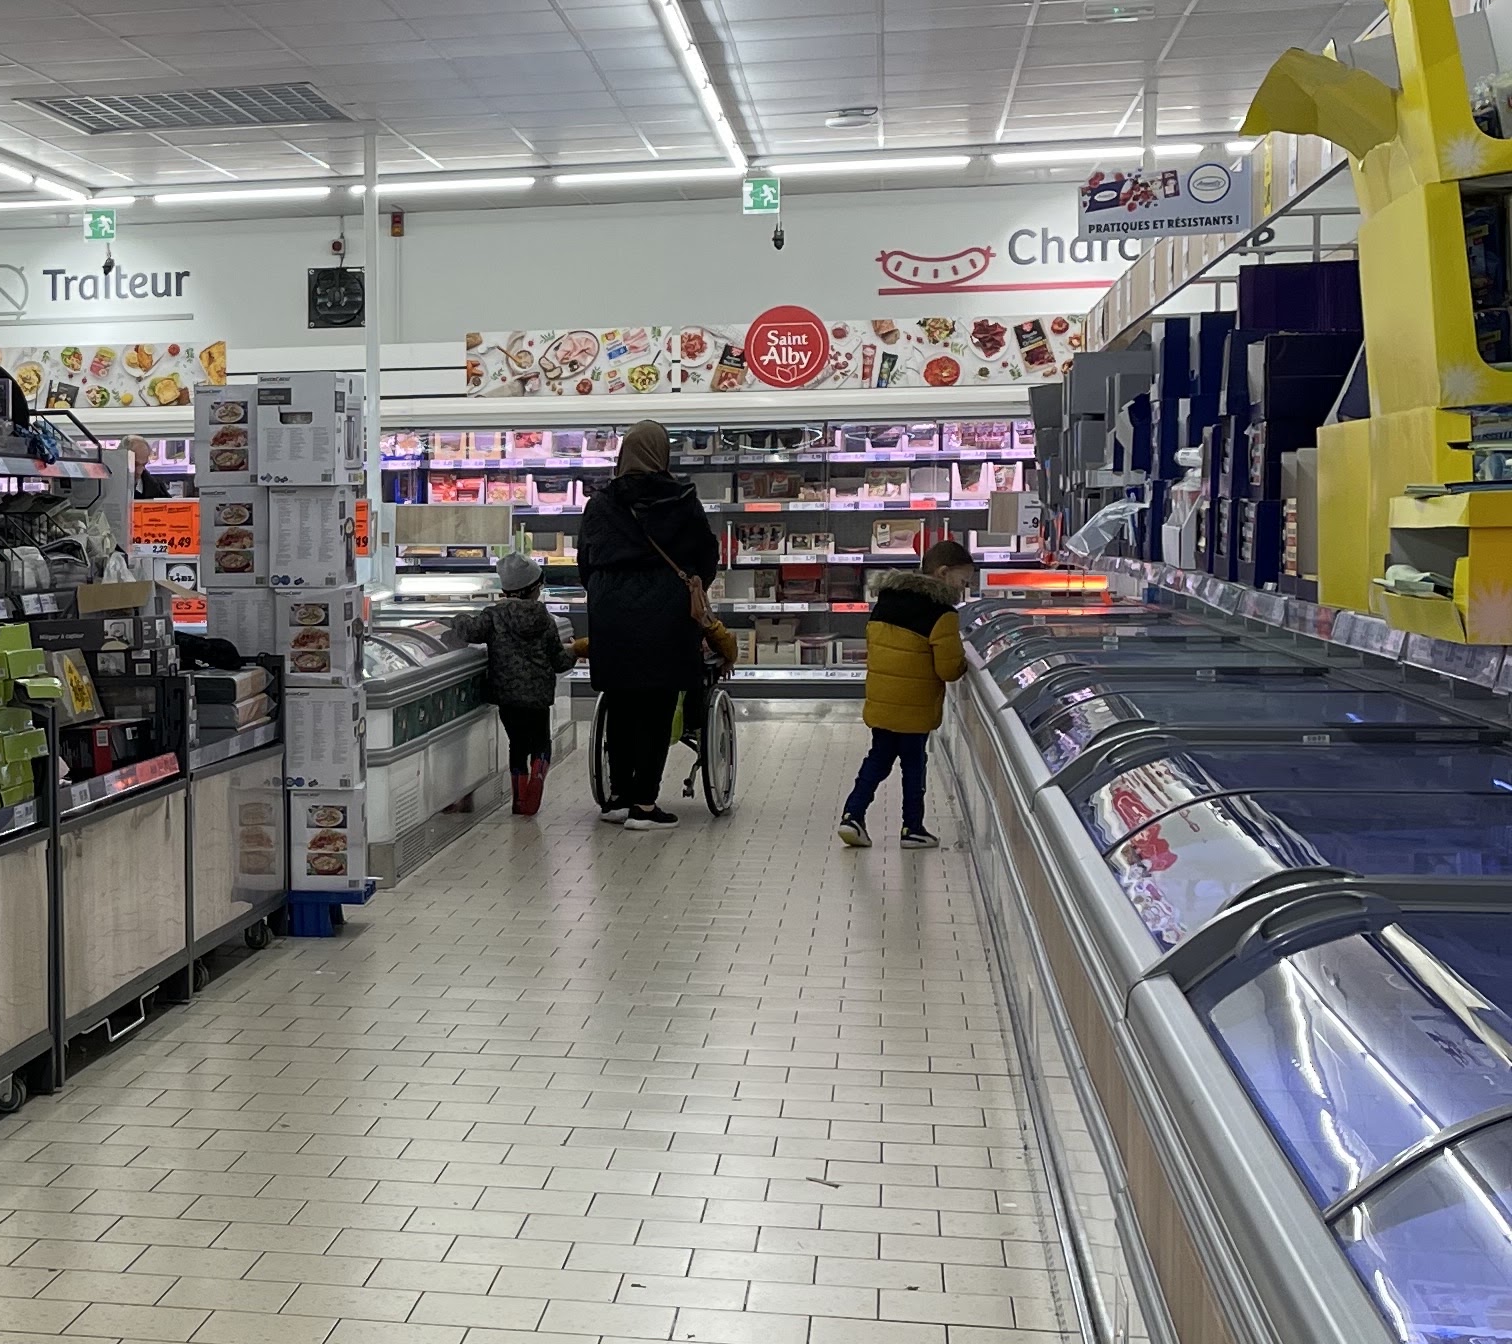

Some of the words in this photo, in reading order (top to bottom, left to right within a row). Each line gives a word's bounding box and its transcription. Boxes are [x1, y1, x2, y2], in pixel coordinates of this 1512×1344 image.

[1088, 221, 1150, 234] PRATIQUES
[1153, 219, 1164, 230] ET
[1167, 215, 1232, 229] RÉSISTANTS
[1008, 227, 1141, 266] Charc
[42, 264, 191, 302] Traiteur
[767, 330, 809, 346] Saint
[759, 346, 812, 369] Alby
[168, 537, 192, 549] 4,49
